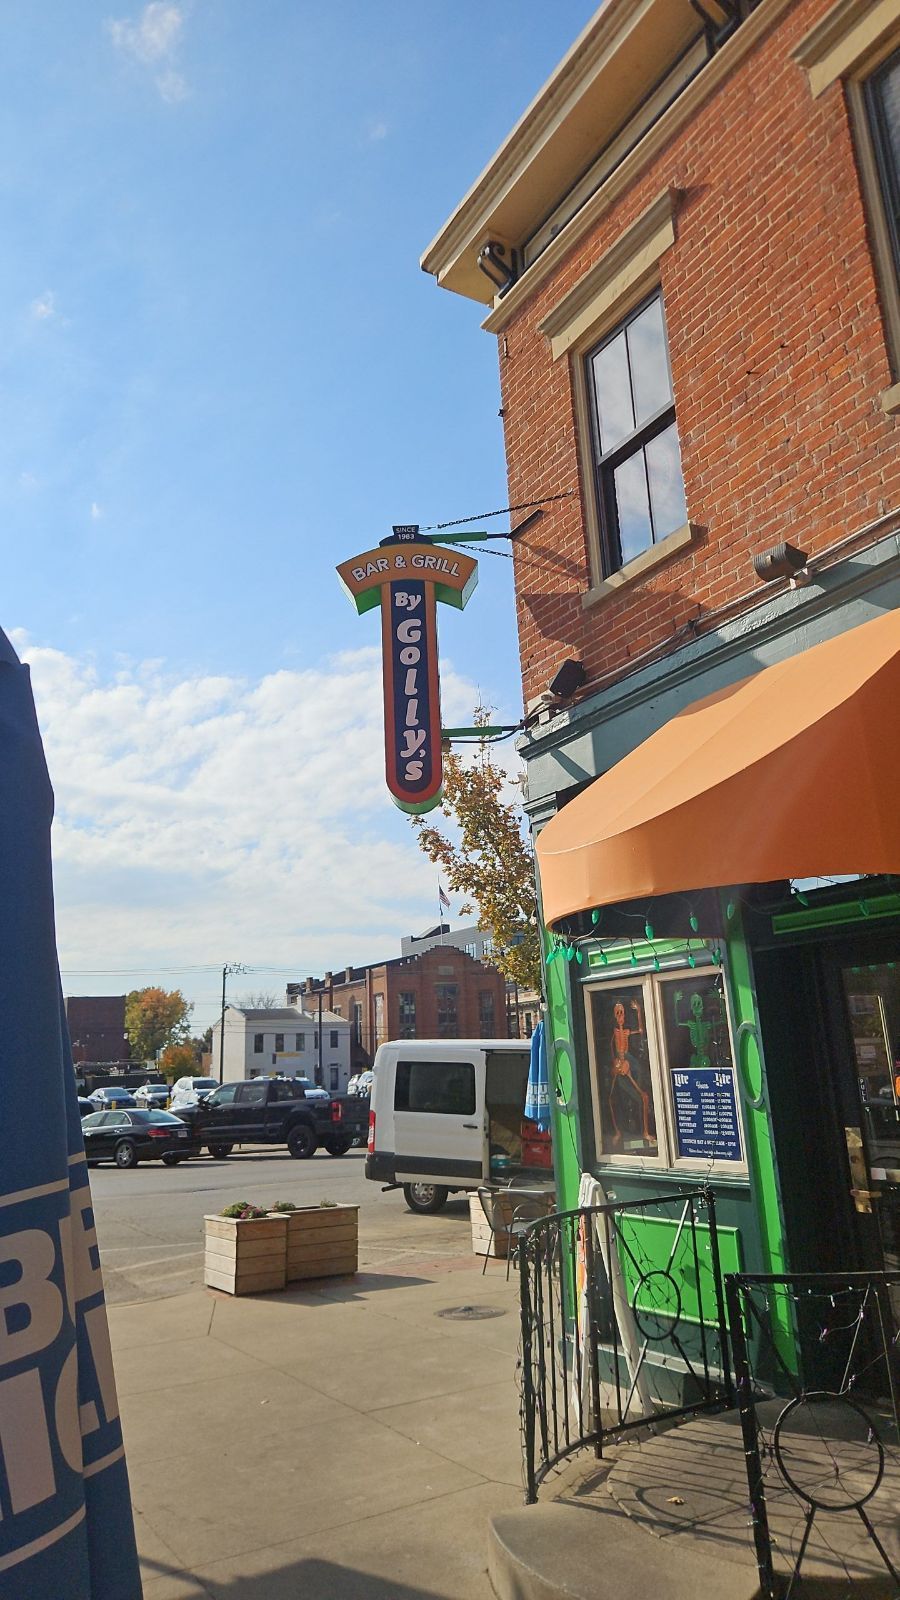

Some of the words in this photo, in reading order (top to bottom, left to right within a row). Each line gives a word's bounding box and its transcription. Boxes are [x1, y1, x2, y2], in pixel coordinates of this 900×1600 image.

[395, 526, 416, 534] SINCE
[352, 558, 390, 581] BAR
[394, 555, 406, 568] &
[411, 554, 460, 577] GRILL
[394, 591, 422, 611] By
[674, 1073, 689, 1087] Lite
